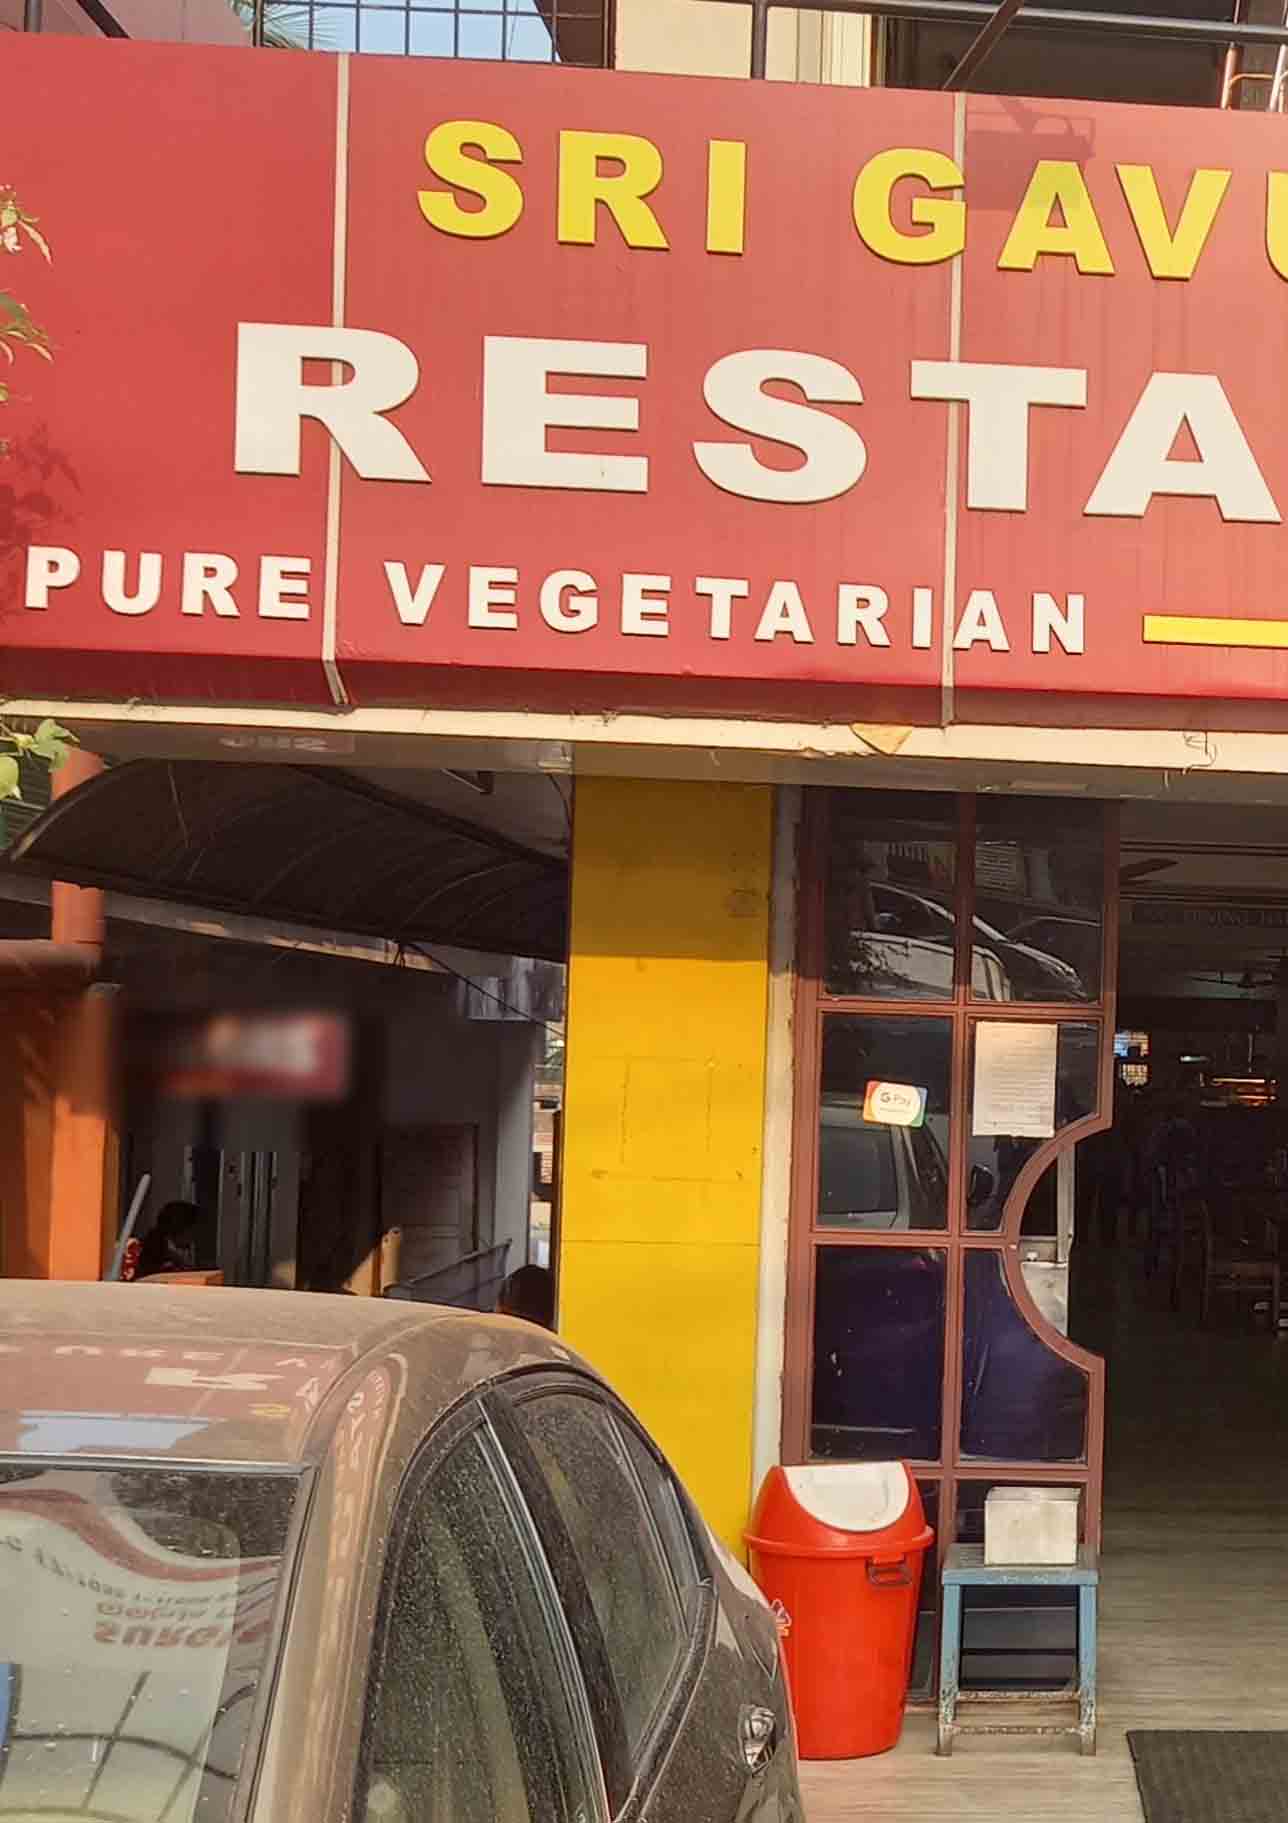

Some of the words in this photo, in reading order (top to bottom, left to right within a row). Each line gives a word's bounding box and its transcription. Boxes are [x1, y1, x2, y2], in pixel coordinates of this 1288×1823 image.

[417, 119, 747, 254] SRI
[24, 545, 312, 619] PURE
[383, 561, 1086, 654] VEGETARIAN
